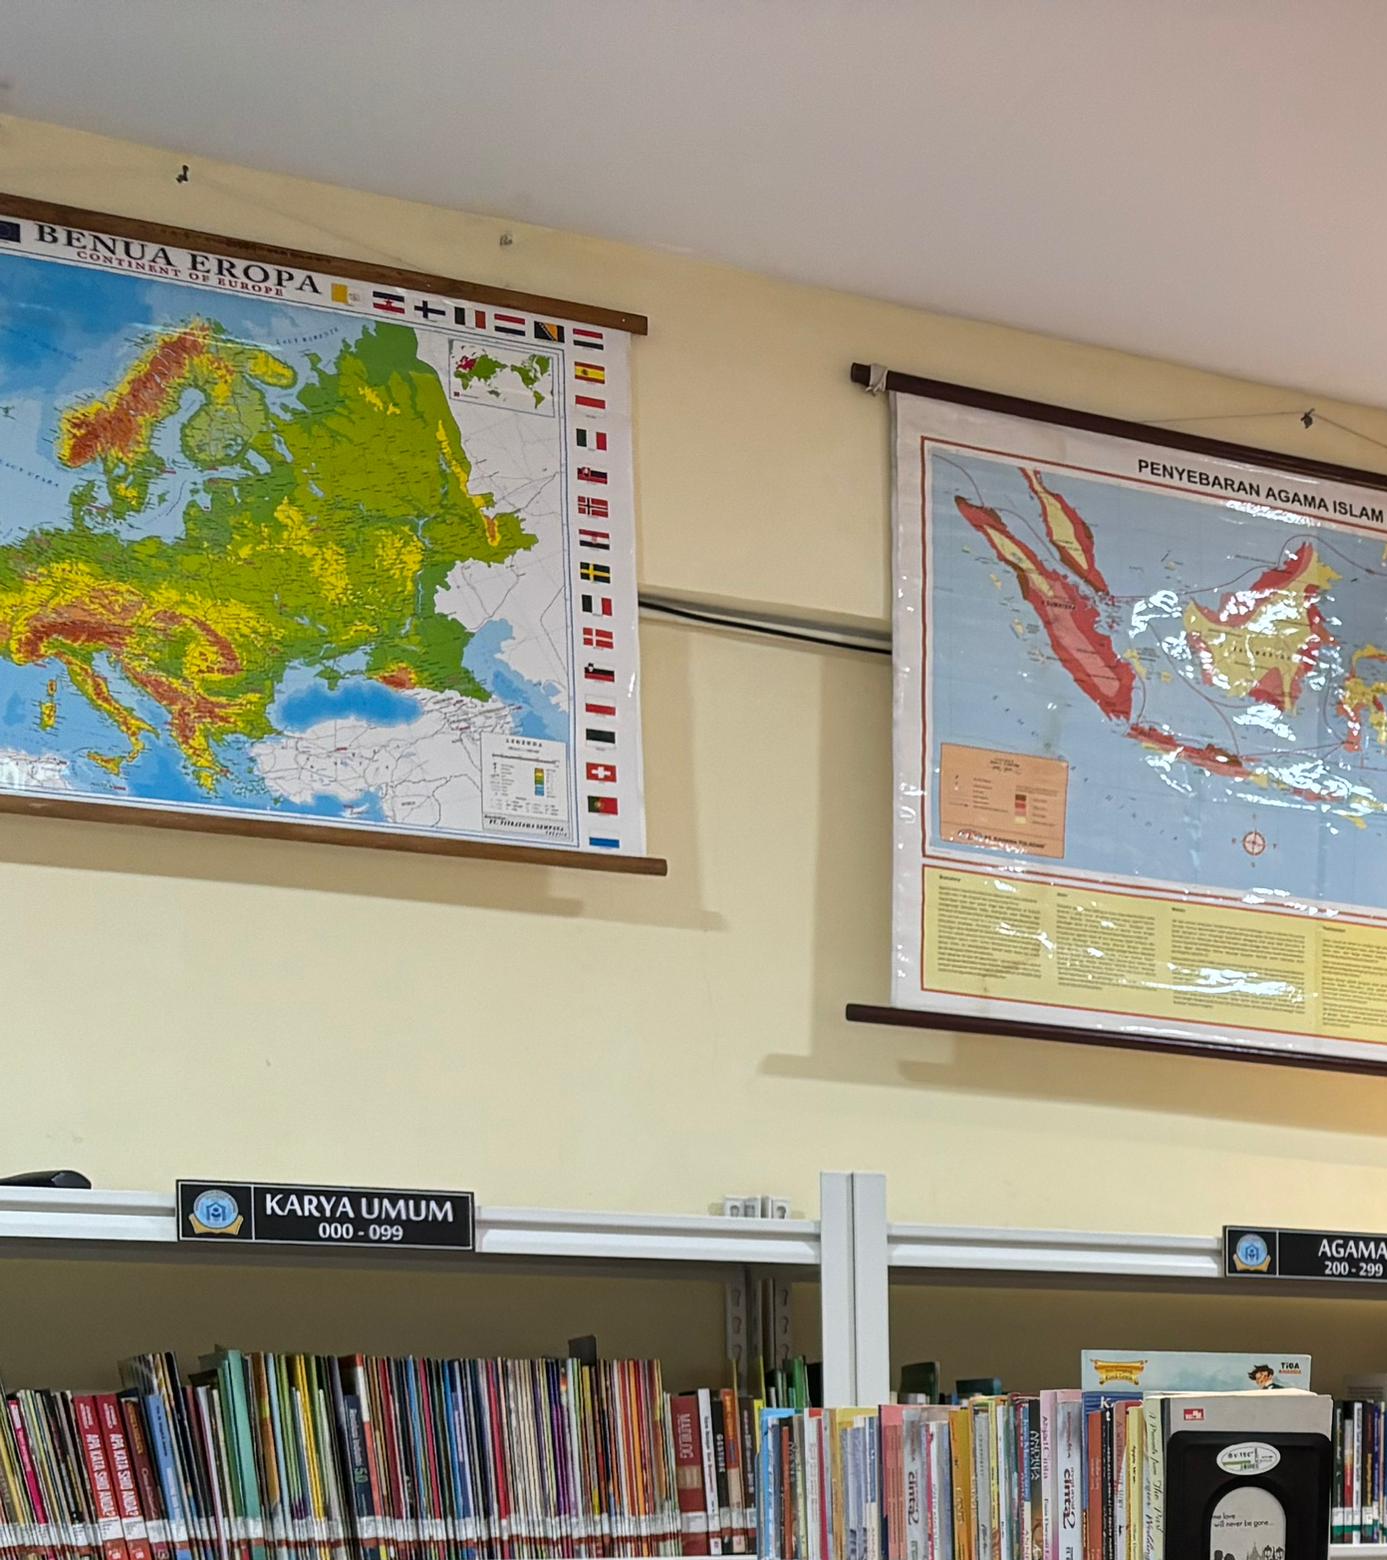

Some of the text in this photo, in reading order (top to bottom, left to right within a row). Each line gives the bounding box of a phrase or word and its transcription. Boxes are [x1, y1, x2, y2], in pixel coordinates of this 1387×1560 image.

[35, 223, 322, 295] BENUA EROPA
[76, 250, 284, 297] CONTINENT OF EUROPE
[1138, 459, 1260, 498] PENYEBARAN
[1265, 487, 1328, 513] AGAMA
[1333, 500, 1384, 525] ISLAM
[265, 1193, 454, 1223] KARYA UMUM
[318, 1222, 353, 1239] 000
[369, 1224, 404, 1242] 099
[1324, 1261, 1349, 1276] 200
[1359, 1262, 1384, 1278] 299
